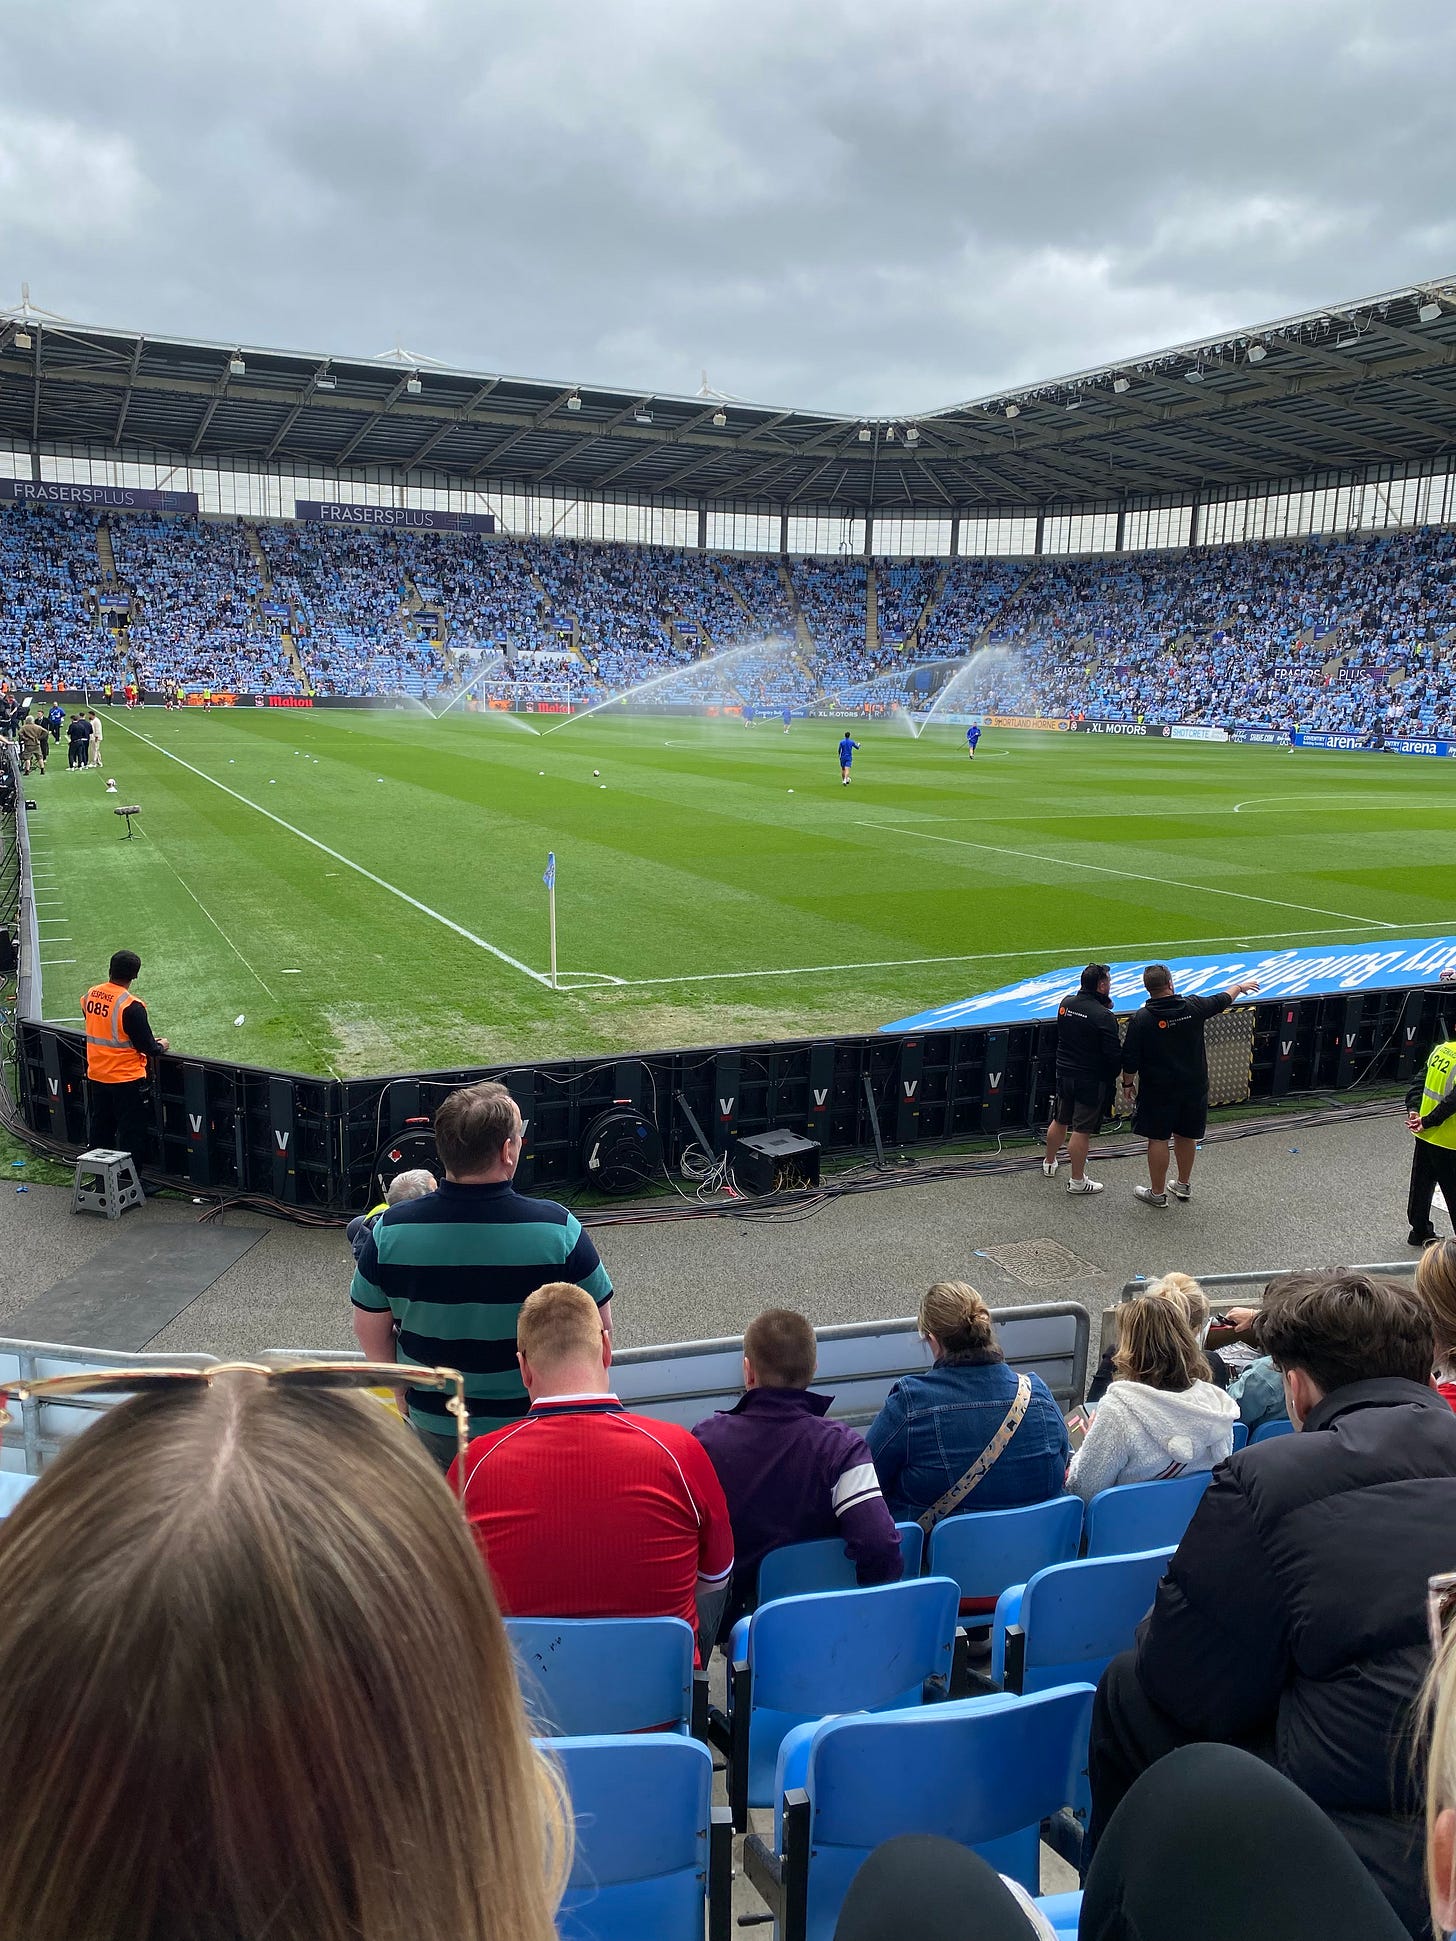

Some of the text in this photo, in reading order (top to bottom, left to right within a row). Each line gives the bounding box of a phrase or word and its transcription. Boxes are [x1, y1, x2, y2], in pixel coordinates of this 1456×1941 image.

[13, 483, 135, 506] FRASERSPLUS
[320, 505, 434, 527] FRASERSPLUS
[268, 695, 313, 707] Mahou
[1091, 722, 1147, 736] XL MOTORS
[1402, 742, 1437, 755] arena
[87, 1000, 110, 1018] 085
[1431, 1054, 1451, 1075] 212
